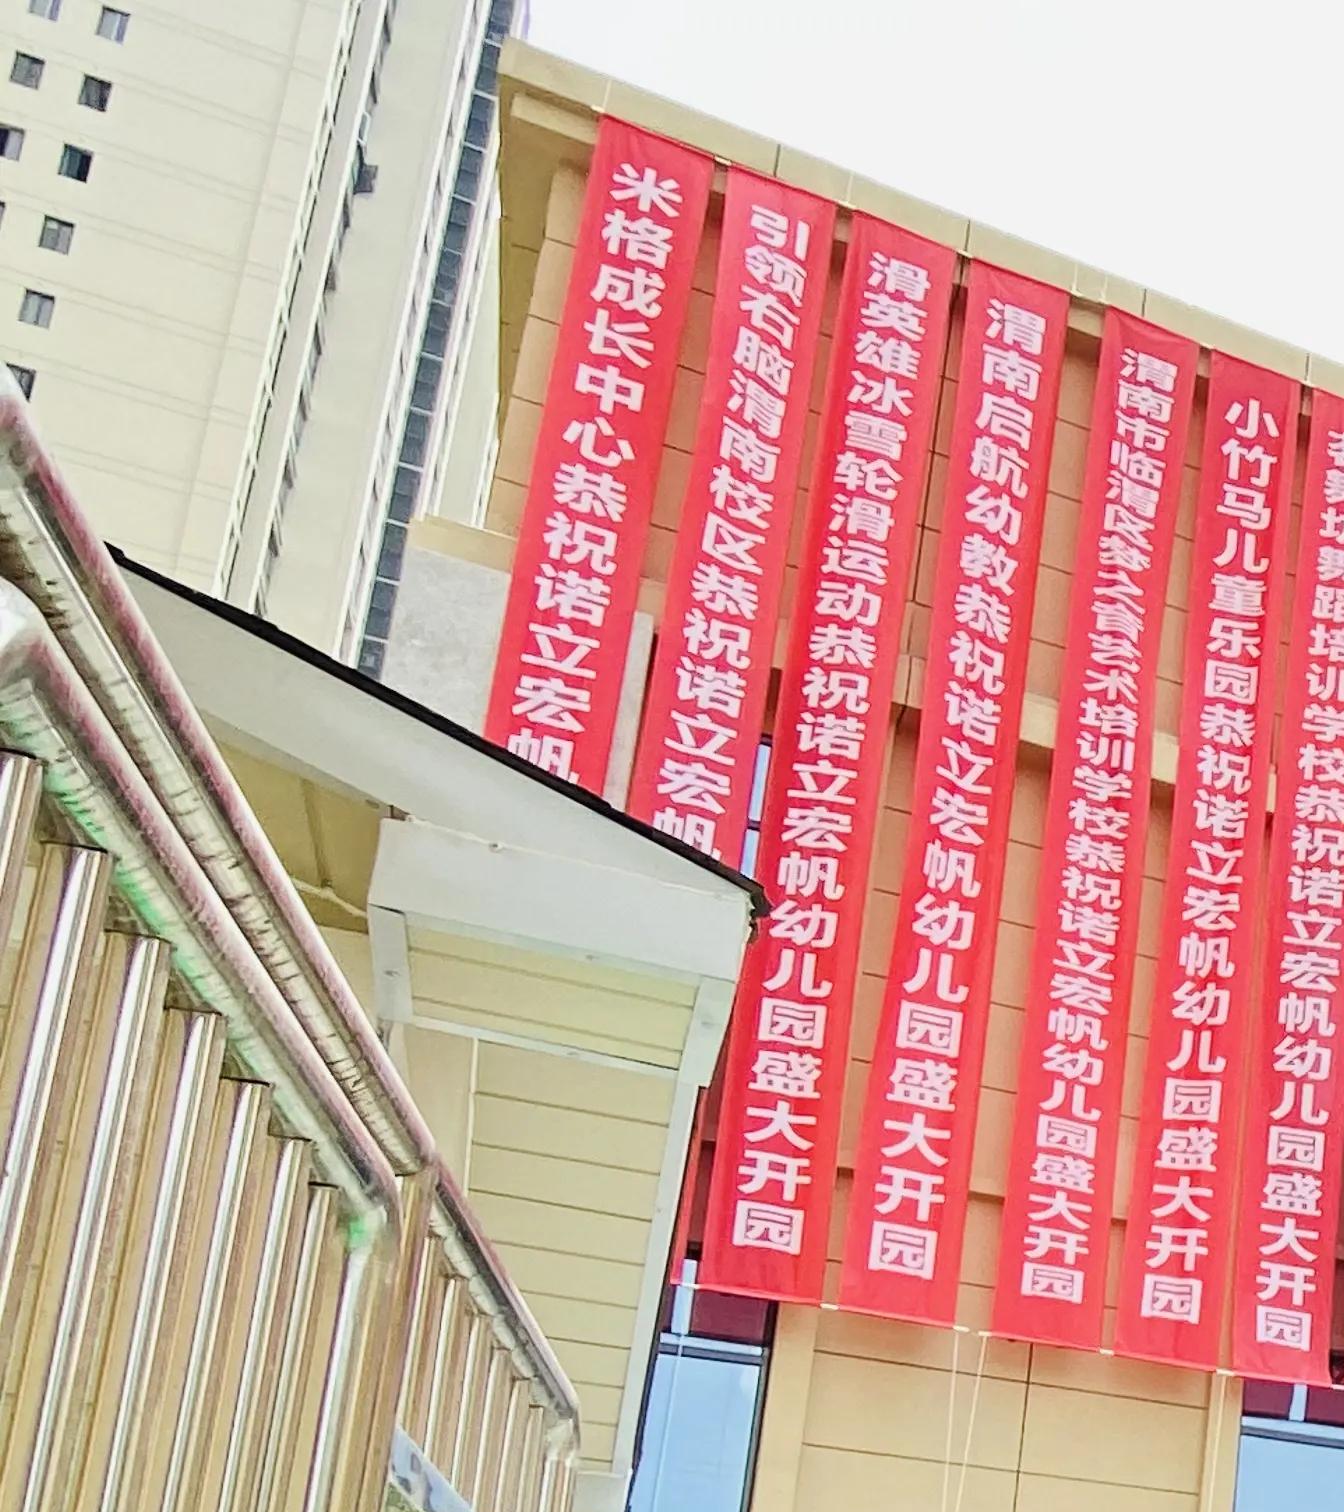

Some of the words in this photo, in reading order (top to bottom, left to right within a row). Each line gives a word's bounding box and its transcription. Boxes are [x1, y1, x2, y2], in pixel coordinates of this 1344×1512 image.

[867, 298, 1047, 1281] 渭南启航幼教恭祝诺立宏帆幼儿园盛大开园
[1139, 398, 1280, 1325] 小竹马儿童乐园恭祝诺立宏帆幼儿园盛大开园
